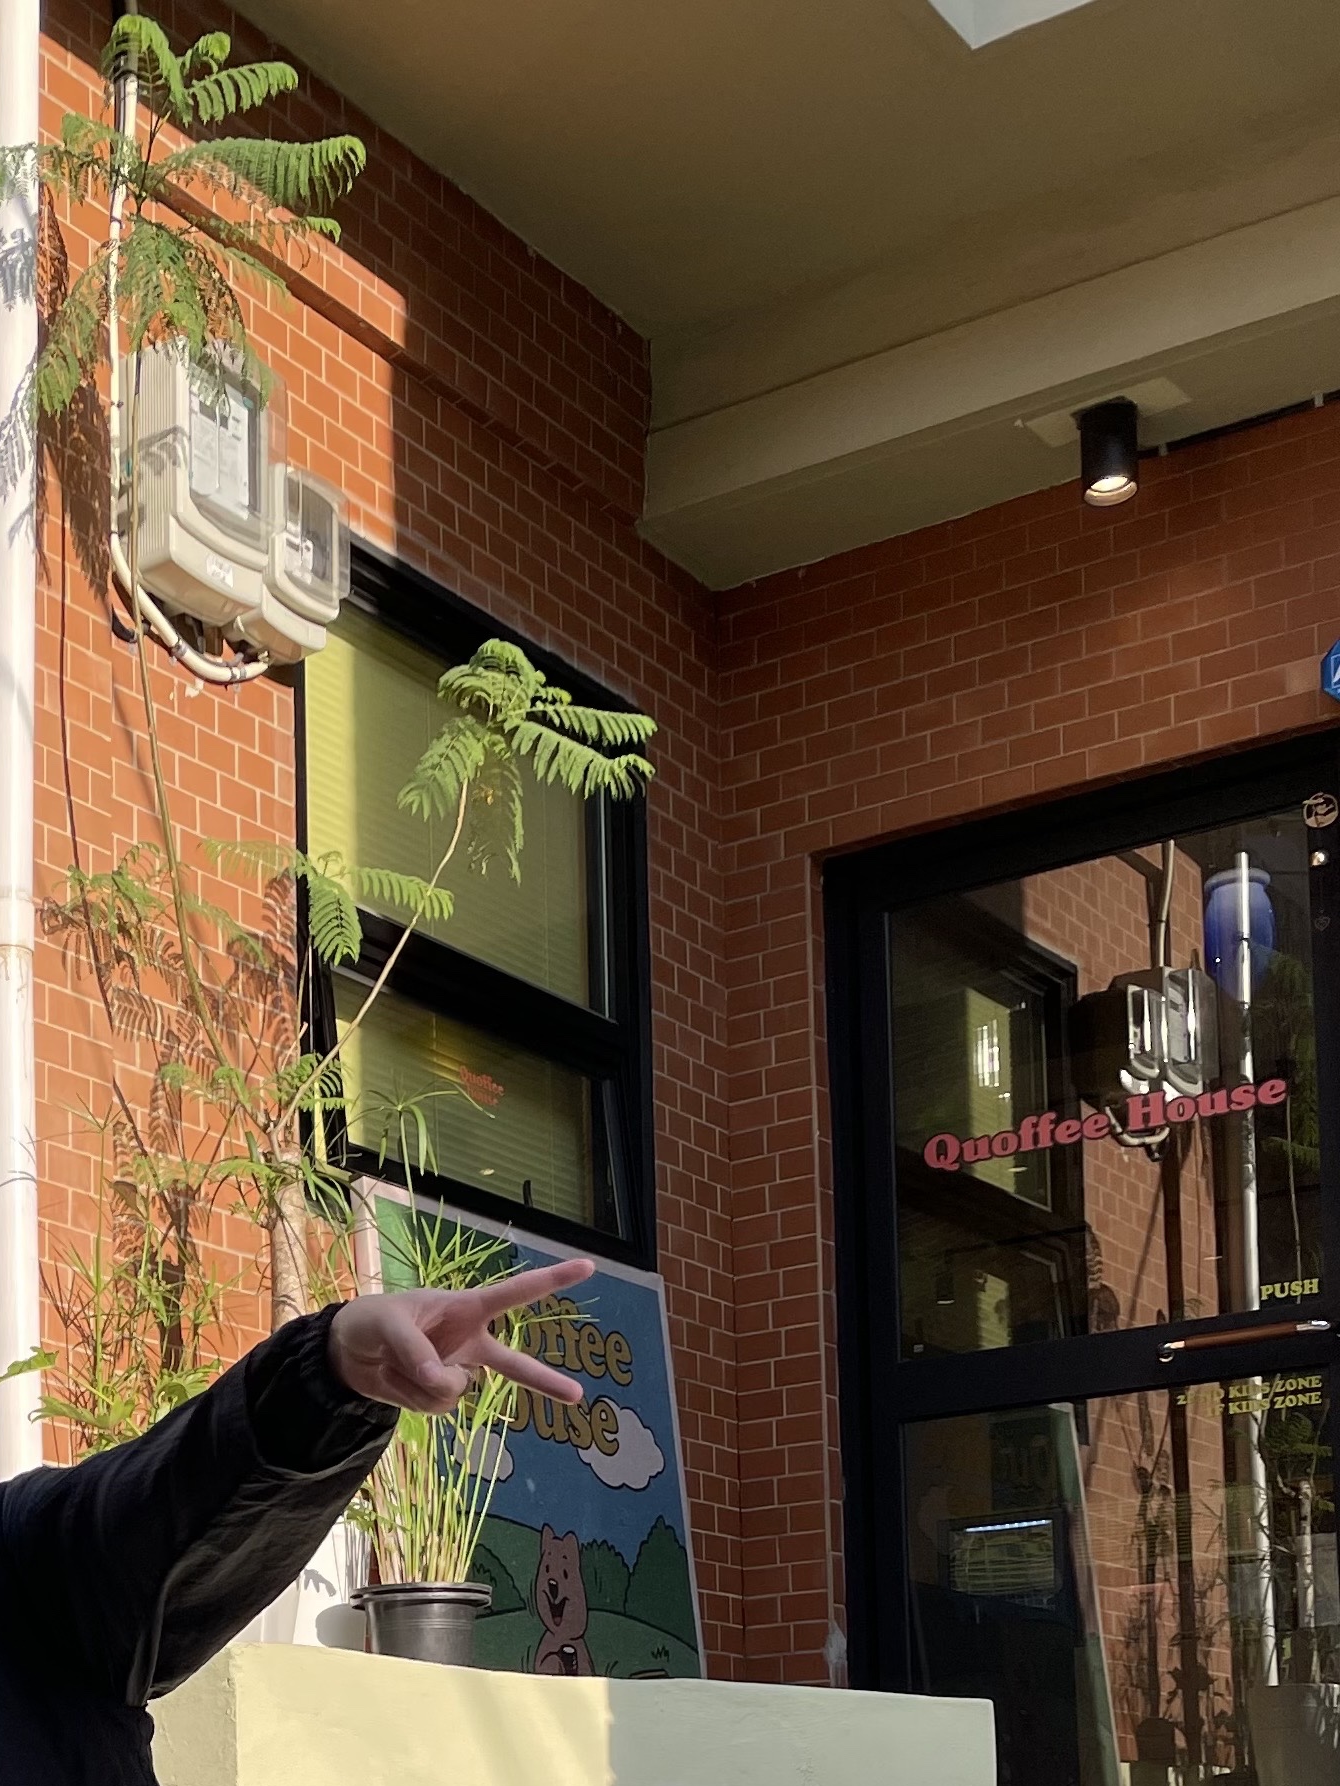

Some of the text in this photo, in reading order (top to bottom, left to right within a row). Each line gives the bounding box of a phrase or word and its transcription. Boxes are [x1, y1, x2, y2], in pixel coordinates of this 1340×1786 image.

[924, 1078, 1289, 1171] Quoffee House
[1260, 1278, 1319, 1300] PUSH
[1274, 1375, 1322, 1393] ZONE
[1274, 1391, 1322, 1409] ZONE
